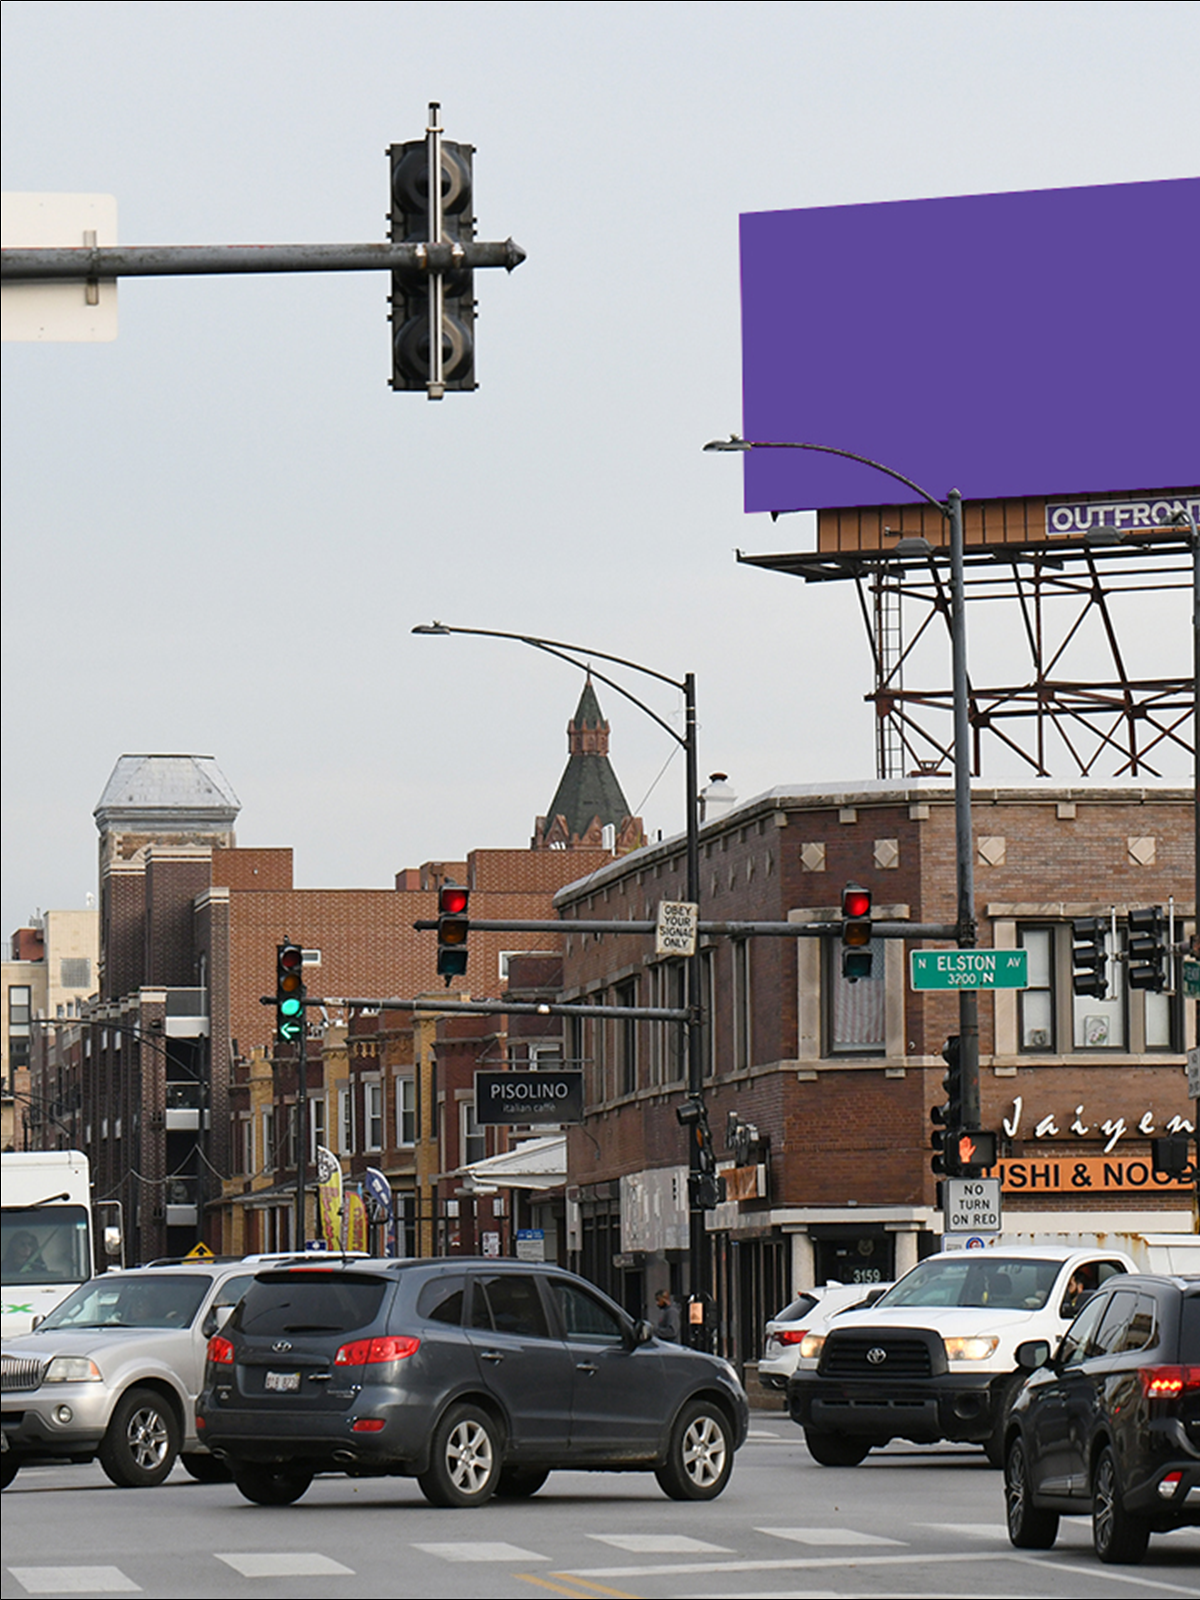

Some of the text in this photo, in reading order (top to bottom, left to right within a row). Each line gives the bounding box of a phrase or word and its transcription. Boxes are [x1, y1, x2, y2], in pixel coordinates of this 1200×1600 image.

[664, 904, 693, 916] OBEY
[664, 916, 691, 927] YOUR
[659, 925, 694, 938] SIGNAL
[663, 937, 689, 948] ONLY
[918, 955, 1021, 972] N ELSTON AV
[947, 972, 994, 985] 3200 N
[490, 1082, 569, 1099] PISOLINO
[1002, 1096, 1195, 1153] Jaiyen
[1070, 1163, 1092, 1187] &
[964, 1184, 984, 1196] NO
[959, 1199, 991, 1210] TURN
[952, 1213, 997, 1225] ON RED
[853, 1268, 881, 1284] 3159
